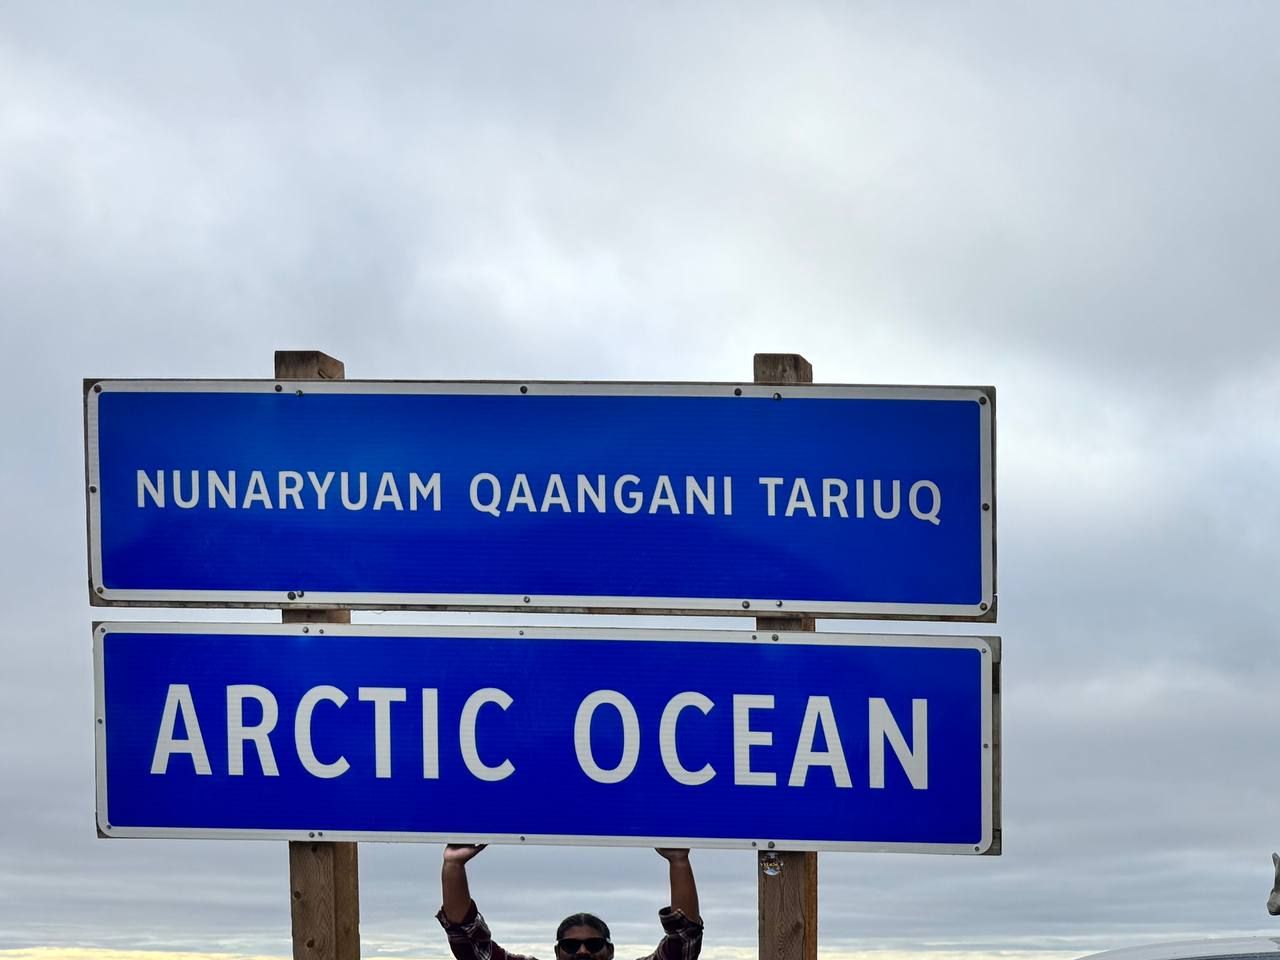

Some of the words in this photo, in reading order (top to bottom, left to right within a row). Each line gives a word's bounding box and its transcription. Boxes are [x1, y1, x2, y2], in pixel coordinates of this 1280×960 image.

[136, 470, 442, 511] NUNARYUAM
[469, 472, 732, 517] QAANGANI
[759, 476, 941, 525] TARIUQ
[150, 684, 516, 782] ARCTIC
[574, 689, 929, 790] OCEAN
